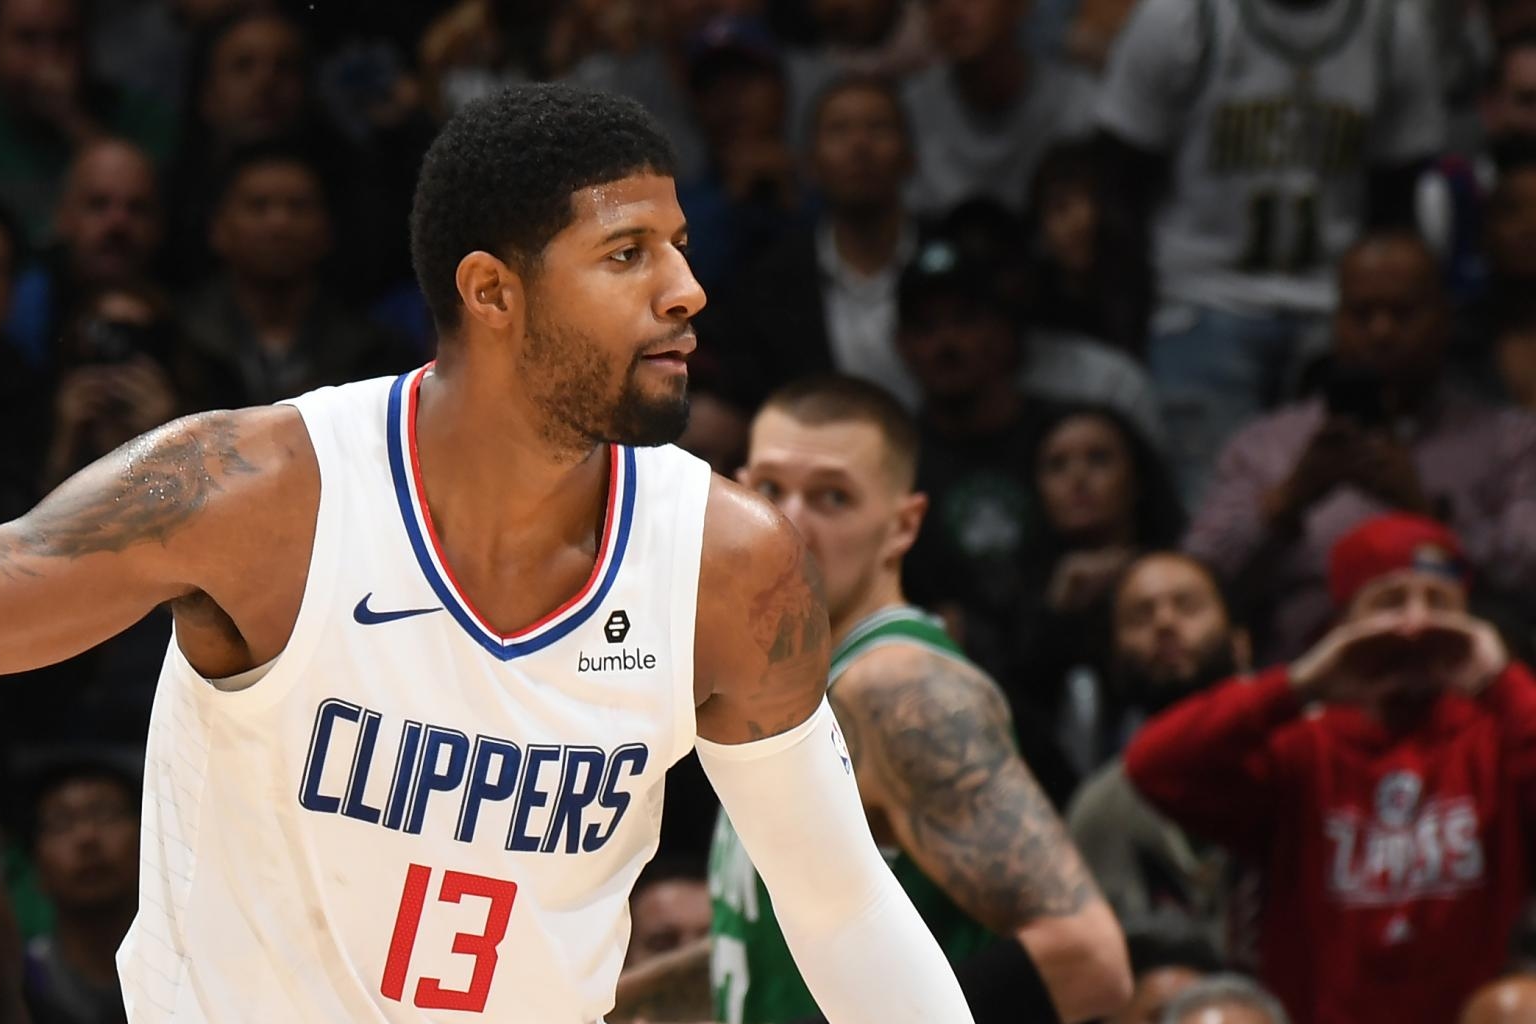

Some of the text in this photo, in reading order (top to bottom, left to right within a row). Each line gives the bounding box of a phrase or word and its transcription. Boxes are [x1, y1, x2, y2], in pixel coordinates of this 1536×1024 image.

[578, 648, 656, 673] bumble
[298, 697, 649, 855] CLIPPERS
[380, 863, 518, 1013] 13
